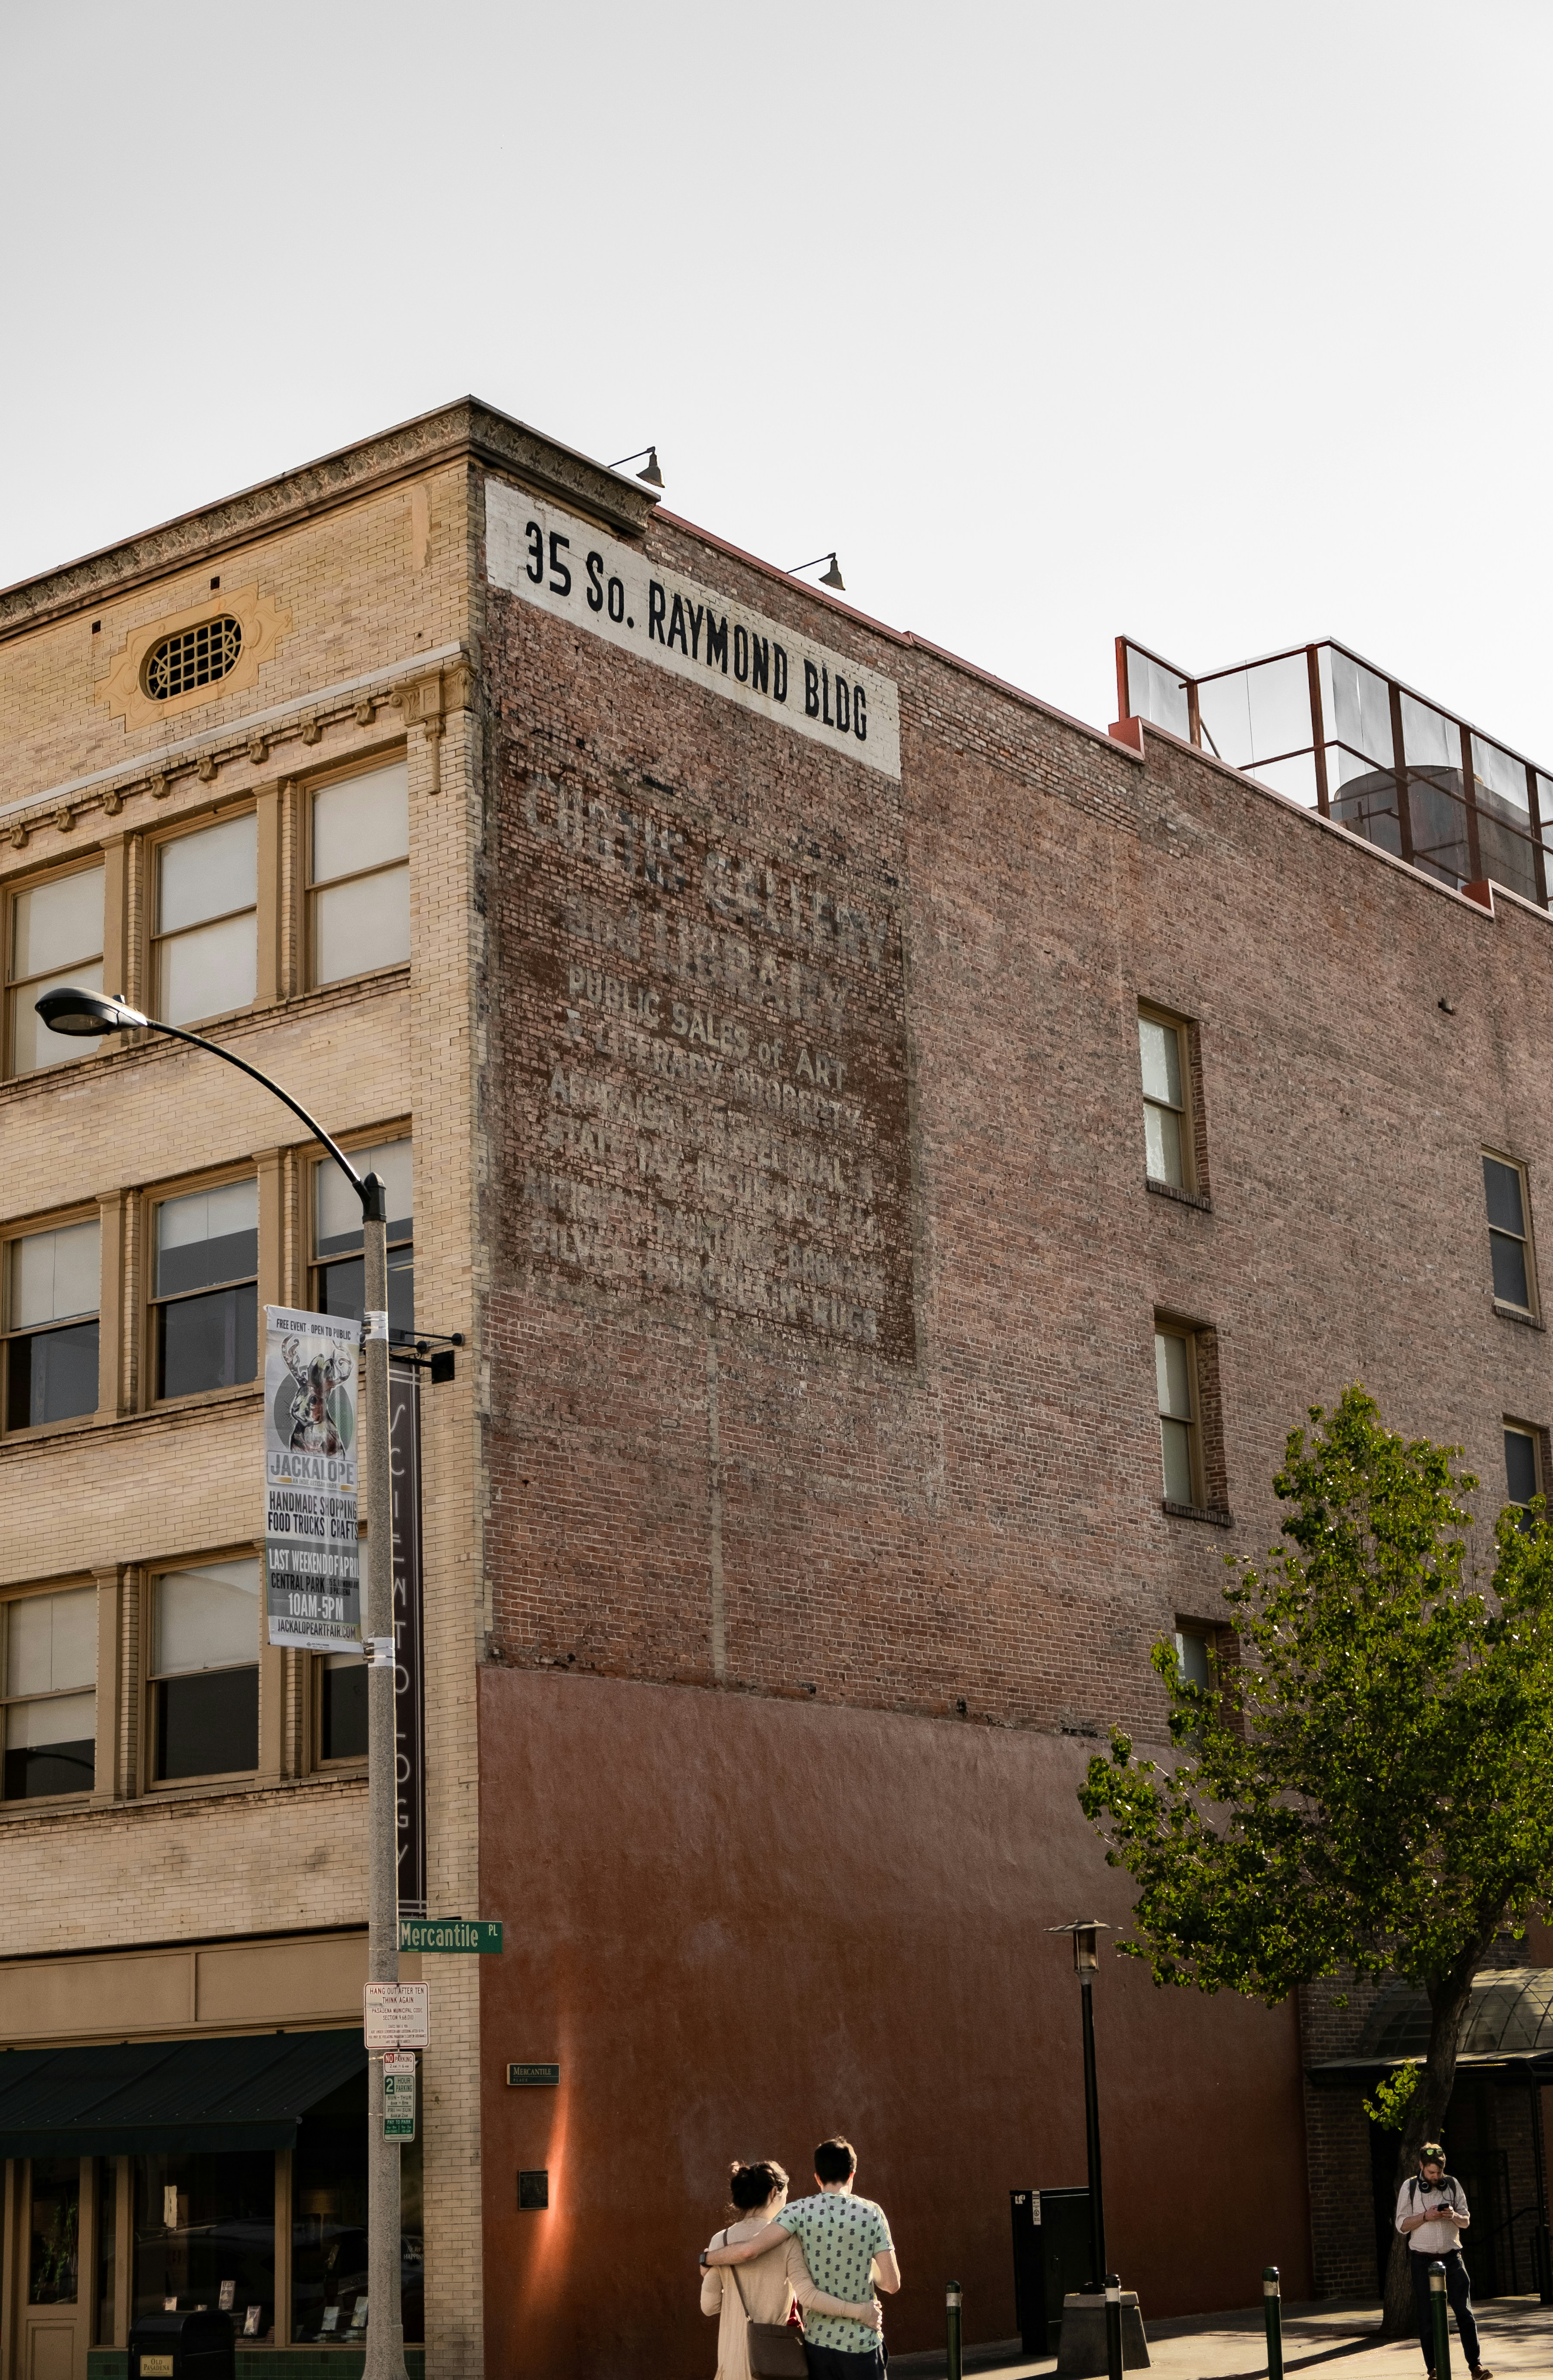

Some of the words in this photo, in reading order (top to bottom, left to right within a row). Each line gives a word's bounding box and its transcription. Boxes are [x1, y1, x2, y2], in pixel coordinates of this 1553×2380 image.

[525, 521, 571, 597] 35
[648, 579, 788, 703] RAYMOND
[804, 658, 867, 742] BLDG
[568, 963, 660, 1029] PUBLIC
[671, 1000, 750, 1061] SALES
[795, 1046, 848, 1093] ART
[277, 1319, 289, 1329] FREE
[290, 1321, 306, 1332] EVENT
[311, 1324, 324, 1335] OPEN
[325, 1327, 332, 1336] TO
[334, 1329, 351, 1340] PUBLIC
[271, 1454, 354, 1484] JACKALOPE
[270, 1491, 317, 1515] HANDMADE
[320, 1496, 357, 1520] SHOPPING
[268, 1512, 290, 1532] FOOD
[293, 1514, 324, 1537] TRUCKS
[331, 1518, 358, 1540] CRAFTS
[269, 1548, 289, 1570] LAST
[292, 1550, 327, 1574] WEEKEND
[328, 1555, 339, 1575] OF
[271, 1572, 304, 1591] CENTRAL
[306, 1576, 325, 1593] PARK
[288, 1593, 343, 1620] 10AM-5PM
[278, 1619, 356, 1638] JACKALOPEARTFAIR.COM
[401, 1922, 478, 1947] Mercantile
[489, 1924, 498, 1936] PL
[385, 2054, 393, 2062] NO
[513, 2067, 552, 2075] MERCANTILE
[386, 2078, 393, 2092] 2
